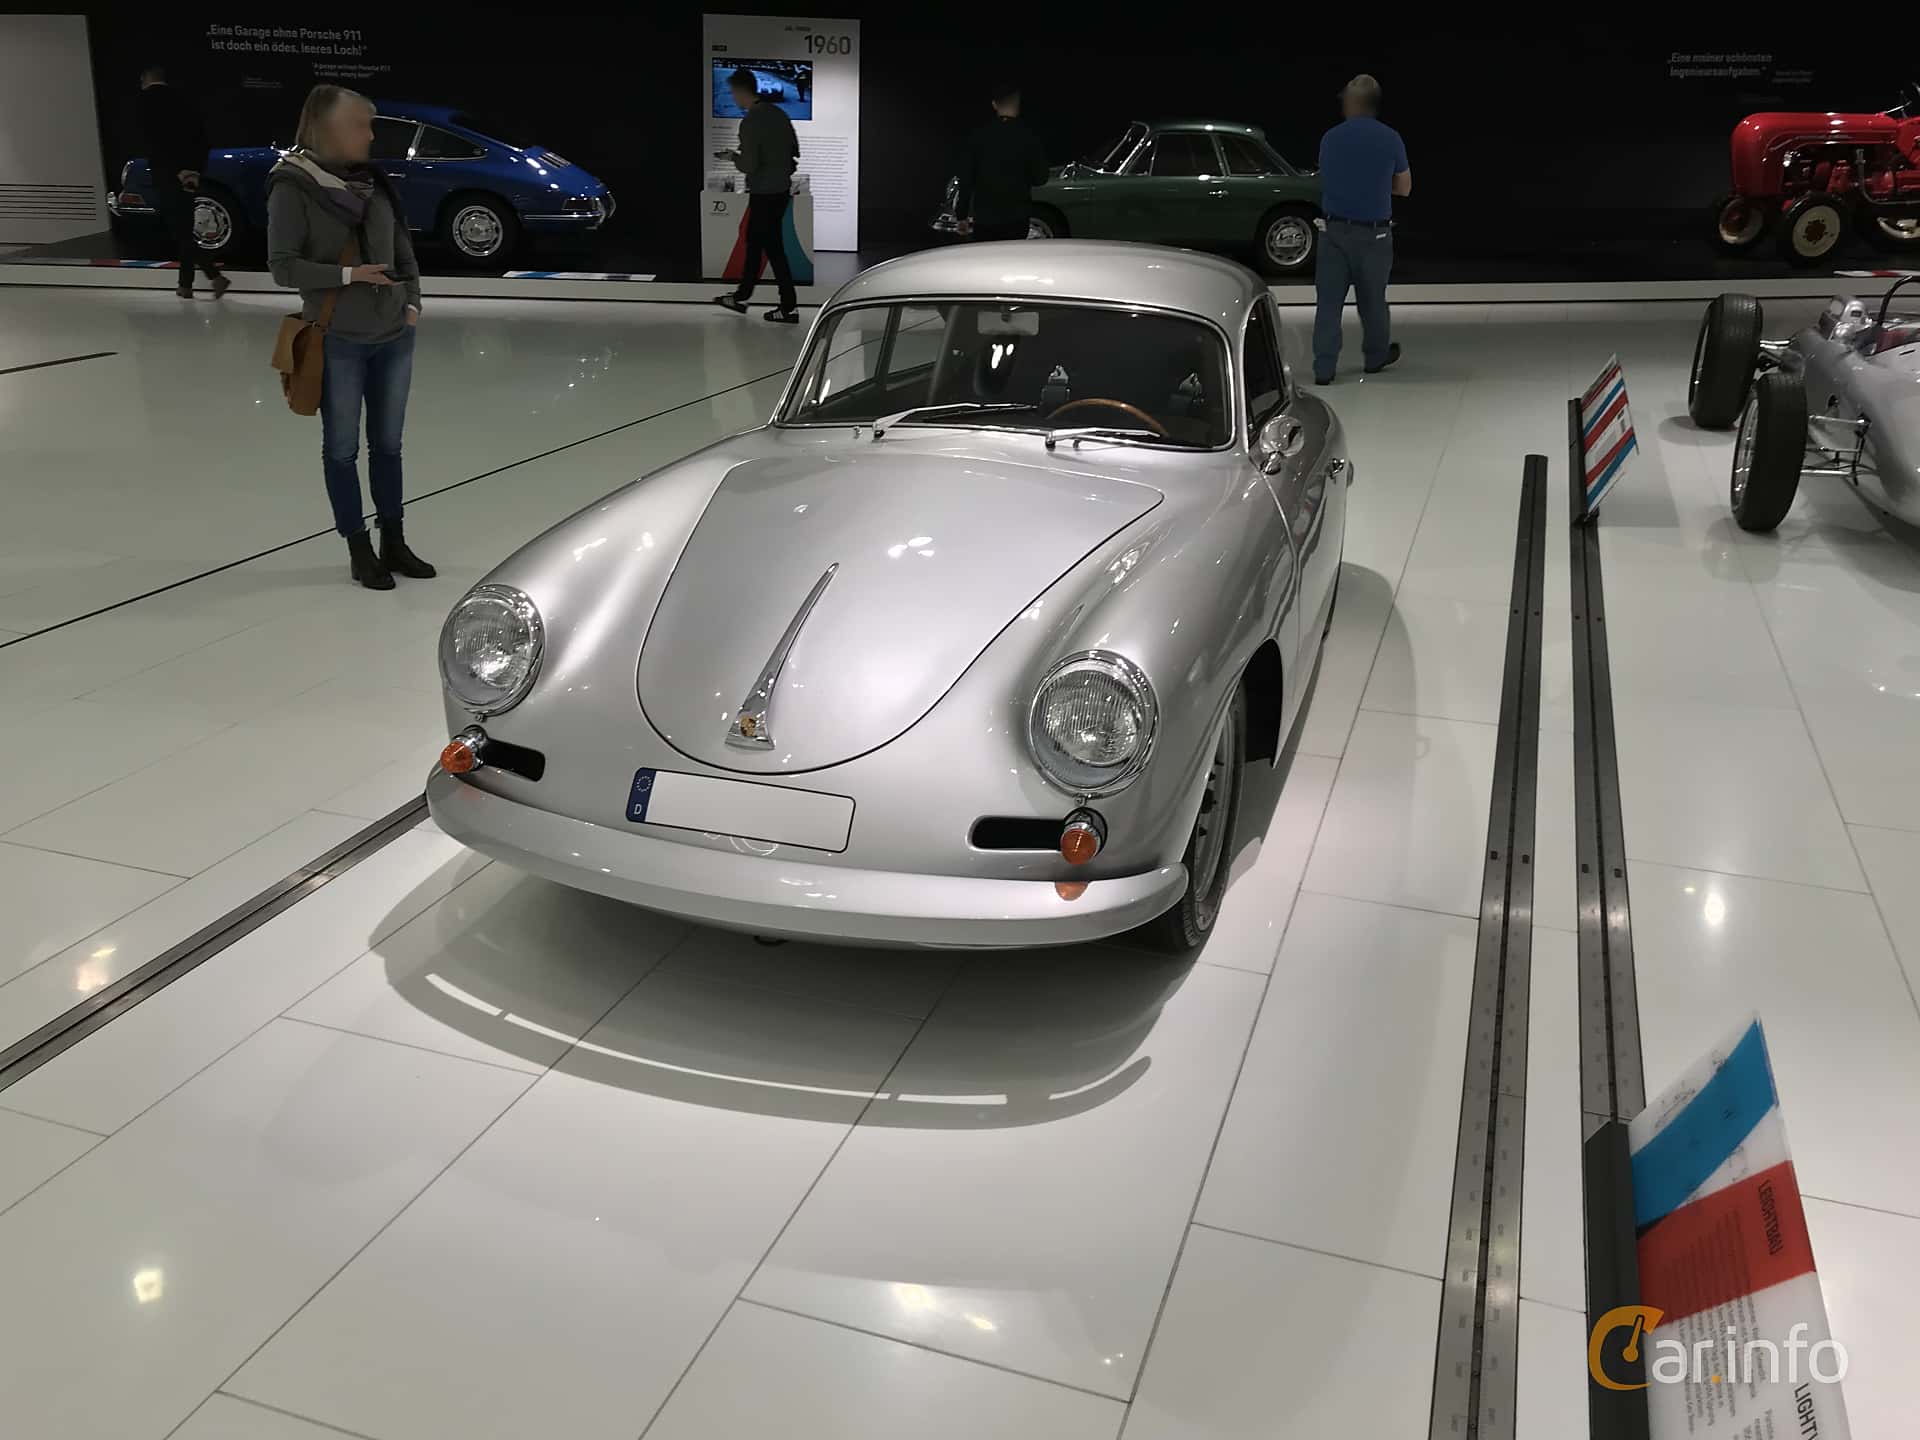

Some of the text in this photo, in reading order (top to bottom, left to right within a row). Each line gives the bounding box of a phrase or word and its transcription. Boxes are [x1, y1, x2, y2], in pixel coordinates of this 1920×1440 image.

[234, 25, 271, 39] Garage
[272, 26, 299, 38] ohne
[299, 28, 342, 40] Porsche
[343, 29, 361, 41] 911
[226, 40, 252, 51] doch
[253, 42, 270, 52] ein
[301, 43, 333, 54] leeres
[804, 35, 851, 55] 1960
[634, 803, 642, 815] D
